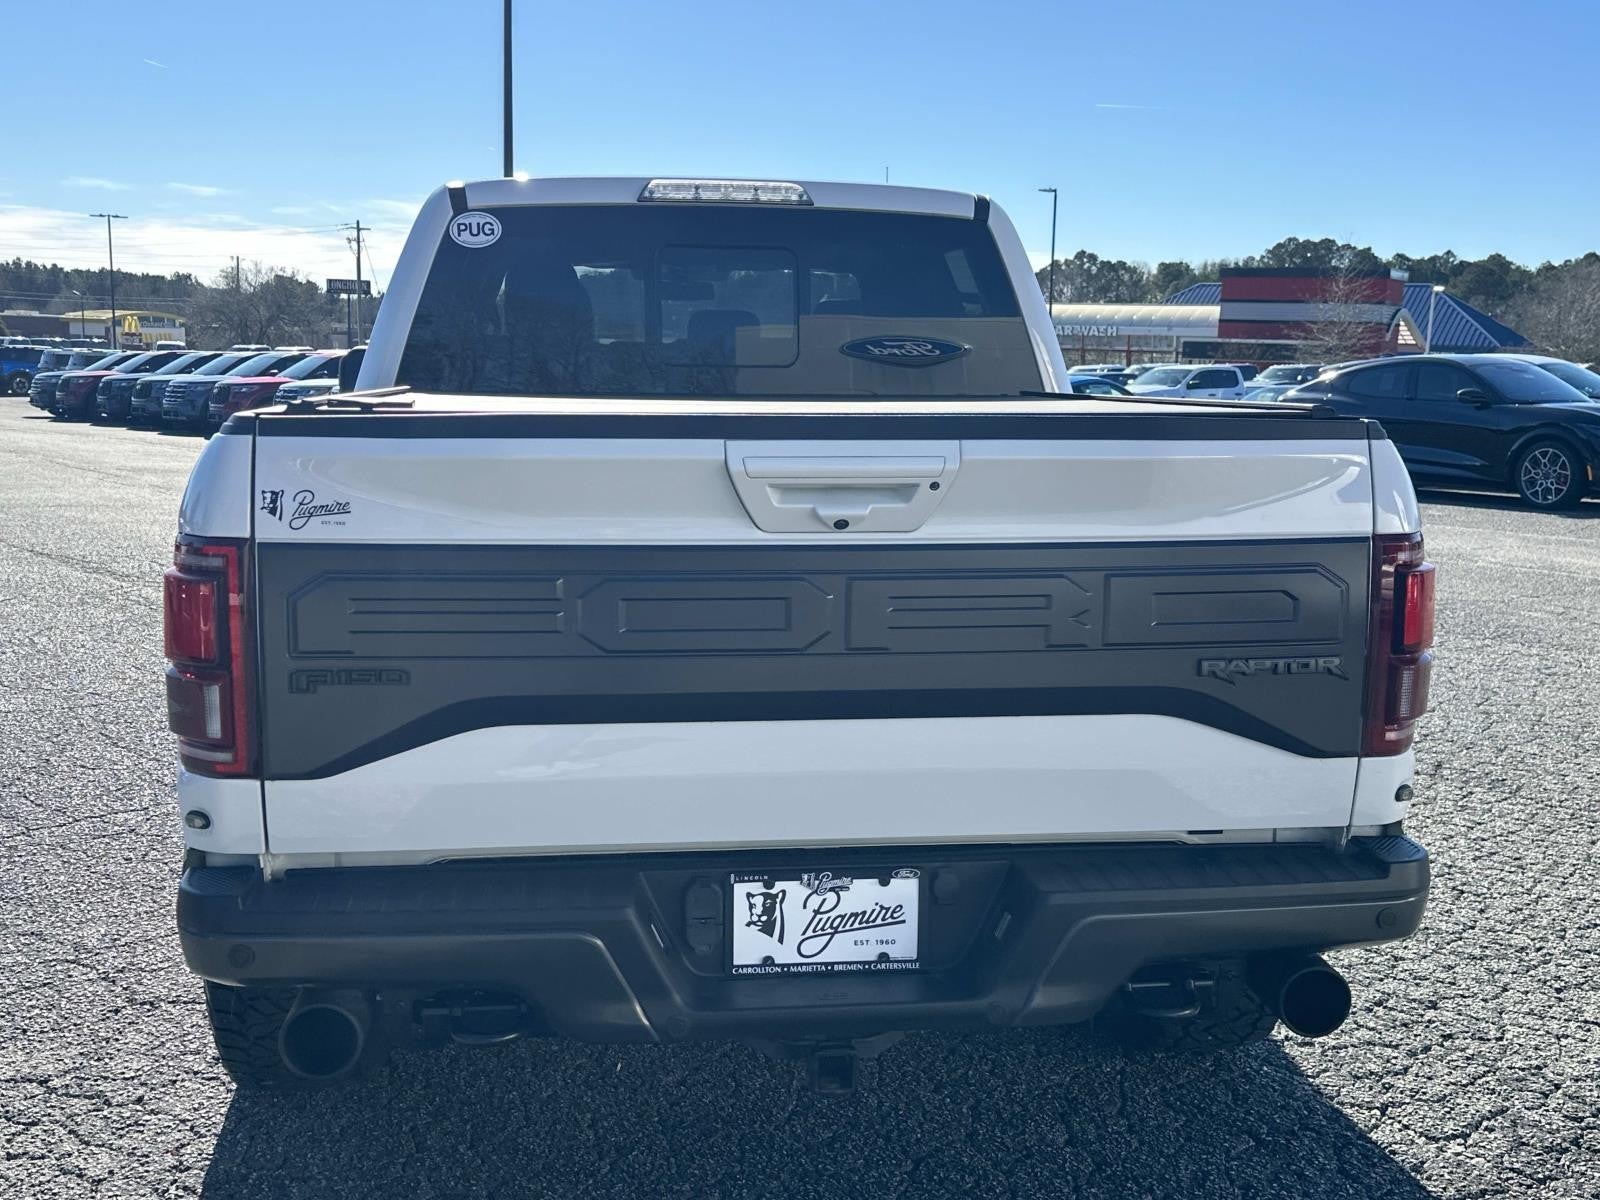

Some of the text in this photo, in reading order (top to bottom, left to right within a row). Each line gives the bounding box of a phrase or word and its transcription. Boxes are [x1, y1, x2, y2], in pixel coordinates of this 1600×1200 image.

[457, 221, 495, 237] PUG
[327, 280, 369, 290] LONGHON
[1055, 325, 1117, 337] AR WASH
[289, 489, 351, 530] Pugmire
[287, 568, 1349, 658] FORD
[1198, 655, 1349, 687] RAPTOR
[816, 872, 853, 896] Pugmire
[897, 870, 915, 878] Ford
[797, 889, 906, 958] Pugmire
[732, 962, 920, 975] CARROLLTON MARIETTA BREMEN CARTERSVILLE
